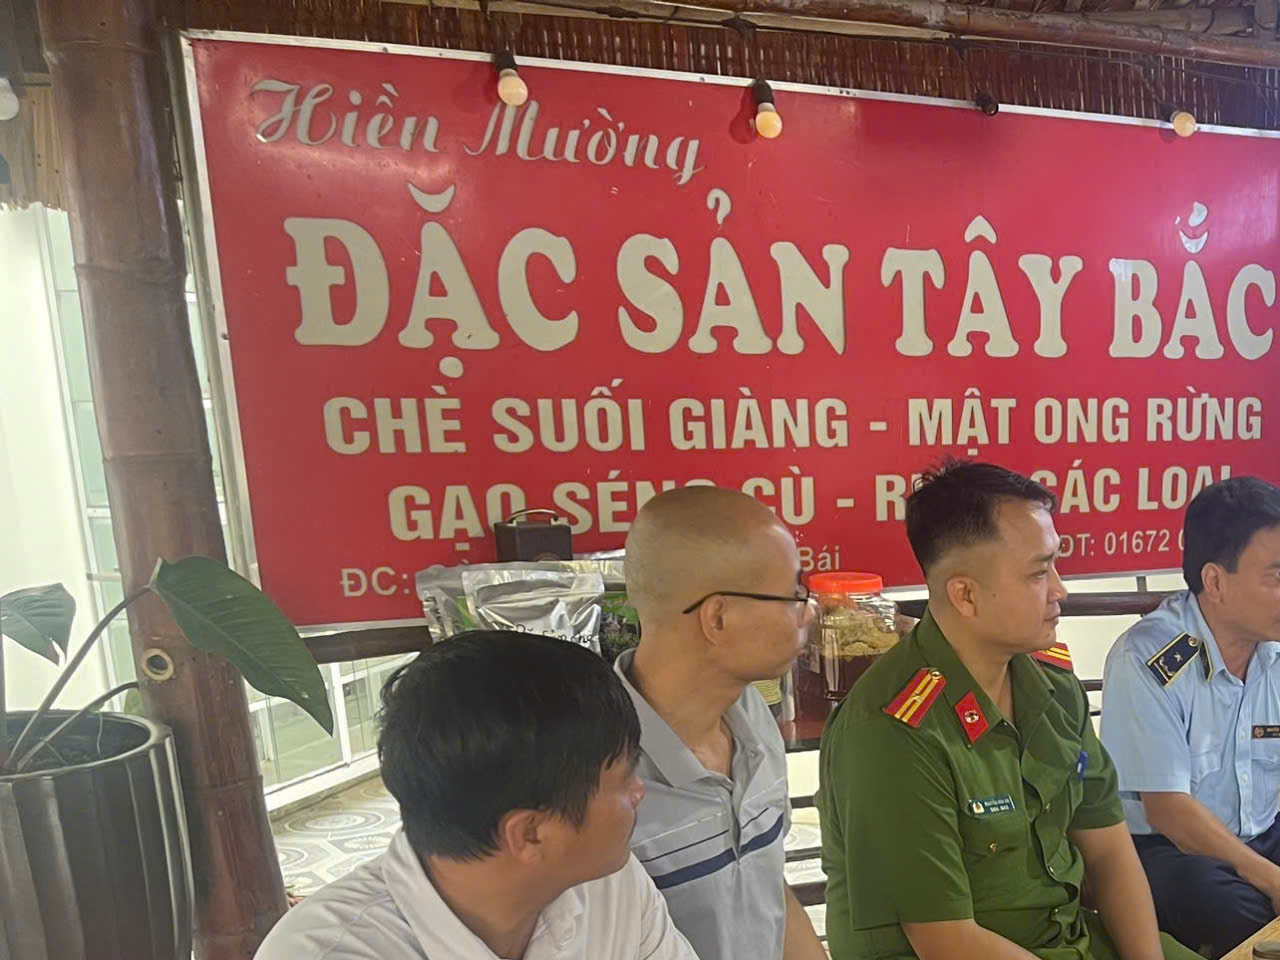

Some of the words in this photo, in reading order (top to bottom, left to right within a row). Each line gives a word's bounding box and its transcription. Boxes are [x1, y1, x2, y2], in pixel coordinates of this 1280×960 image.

[250, 79, 440, 154] Hiền
[463, 99, 704, 186] Mường
[283, 183, 579, 379] ĐẶC
[617, 188, 850, 356] SẢN
[880, 214, 1084, 358] TÂY
[1108, 201, 1277, 361] BẮC
[323, 384, 467, 455] CHÈ
[491, 378, 647, 453] SUỐI
[668, 386, 848, 451] GIÀNG
[908, 387, 1016, 456] MẬT
[1033, 397, 1130, 446] ONG
[1146, 386, 1263, 442] RỪNG
[340, 565, 410, 598] ĐC:
[798, 545, 841, 572] Bái
[1104, 529, 1171, 556] 01672
